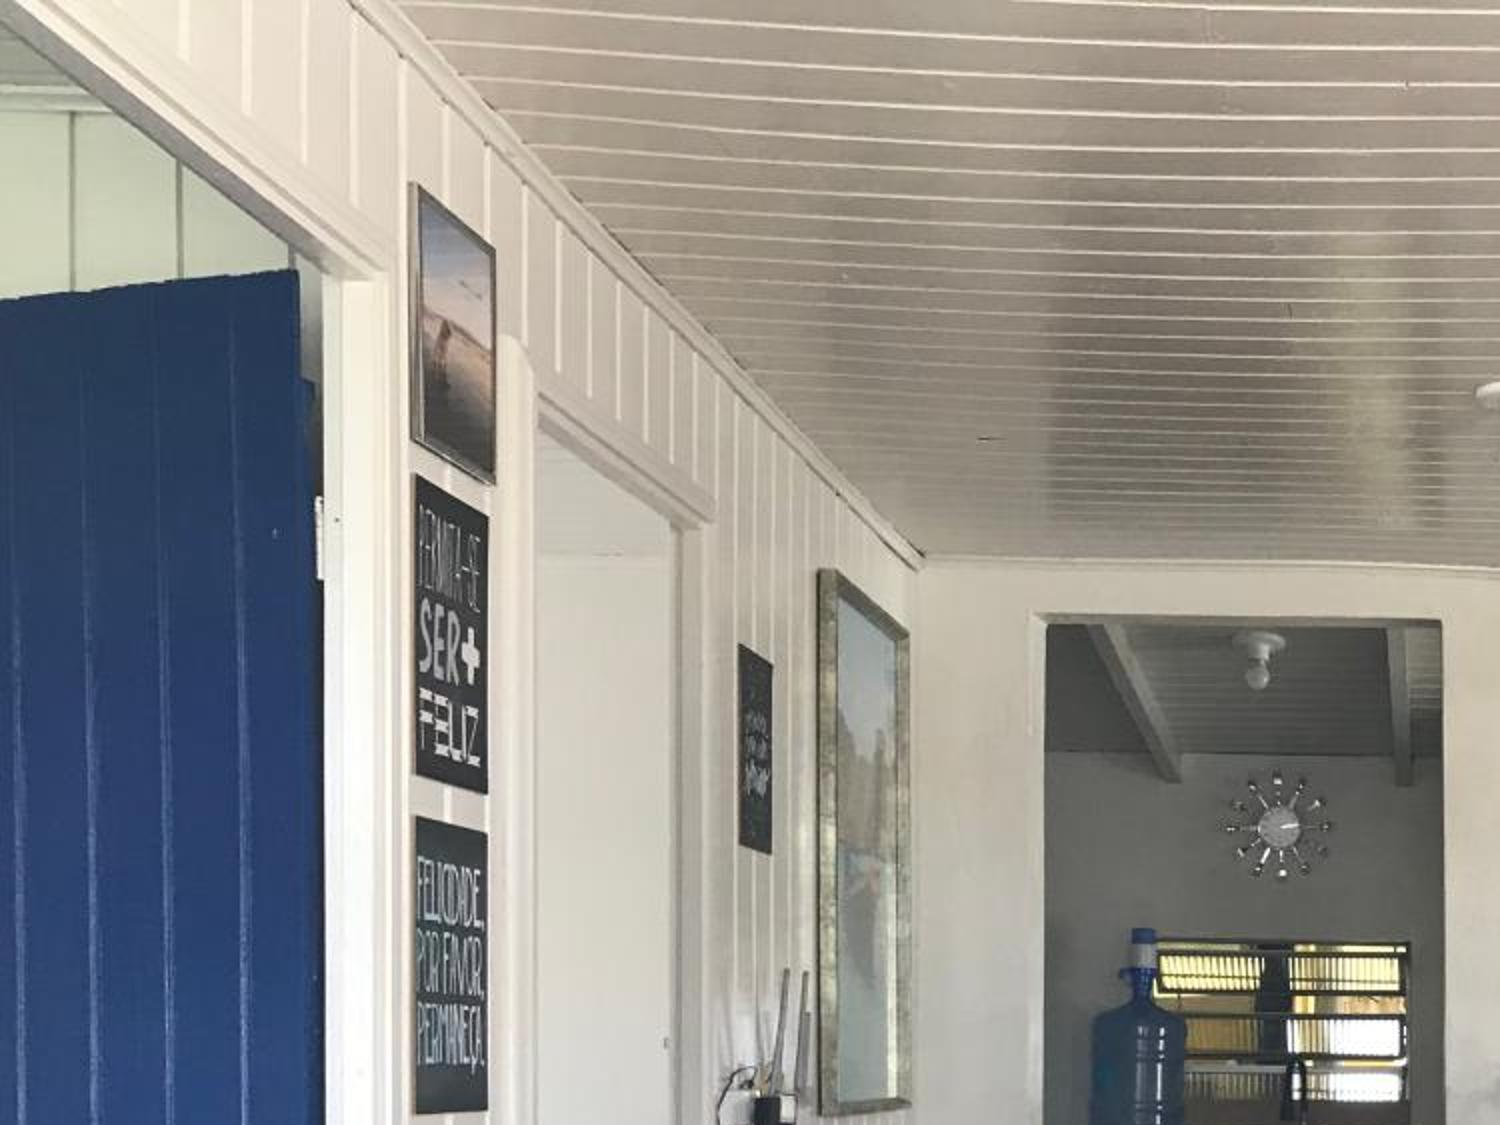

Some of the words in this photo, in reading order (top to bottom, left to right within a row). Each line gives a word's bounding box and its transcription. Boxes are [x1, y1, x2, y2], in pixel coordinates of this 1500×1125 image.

[419, 598, 460, 685] SER
[419, 688, 481, 768] FELIZ
[416, 928, 439, 993] POR
